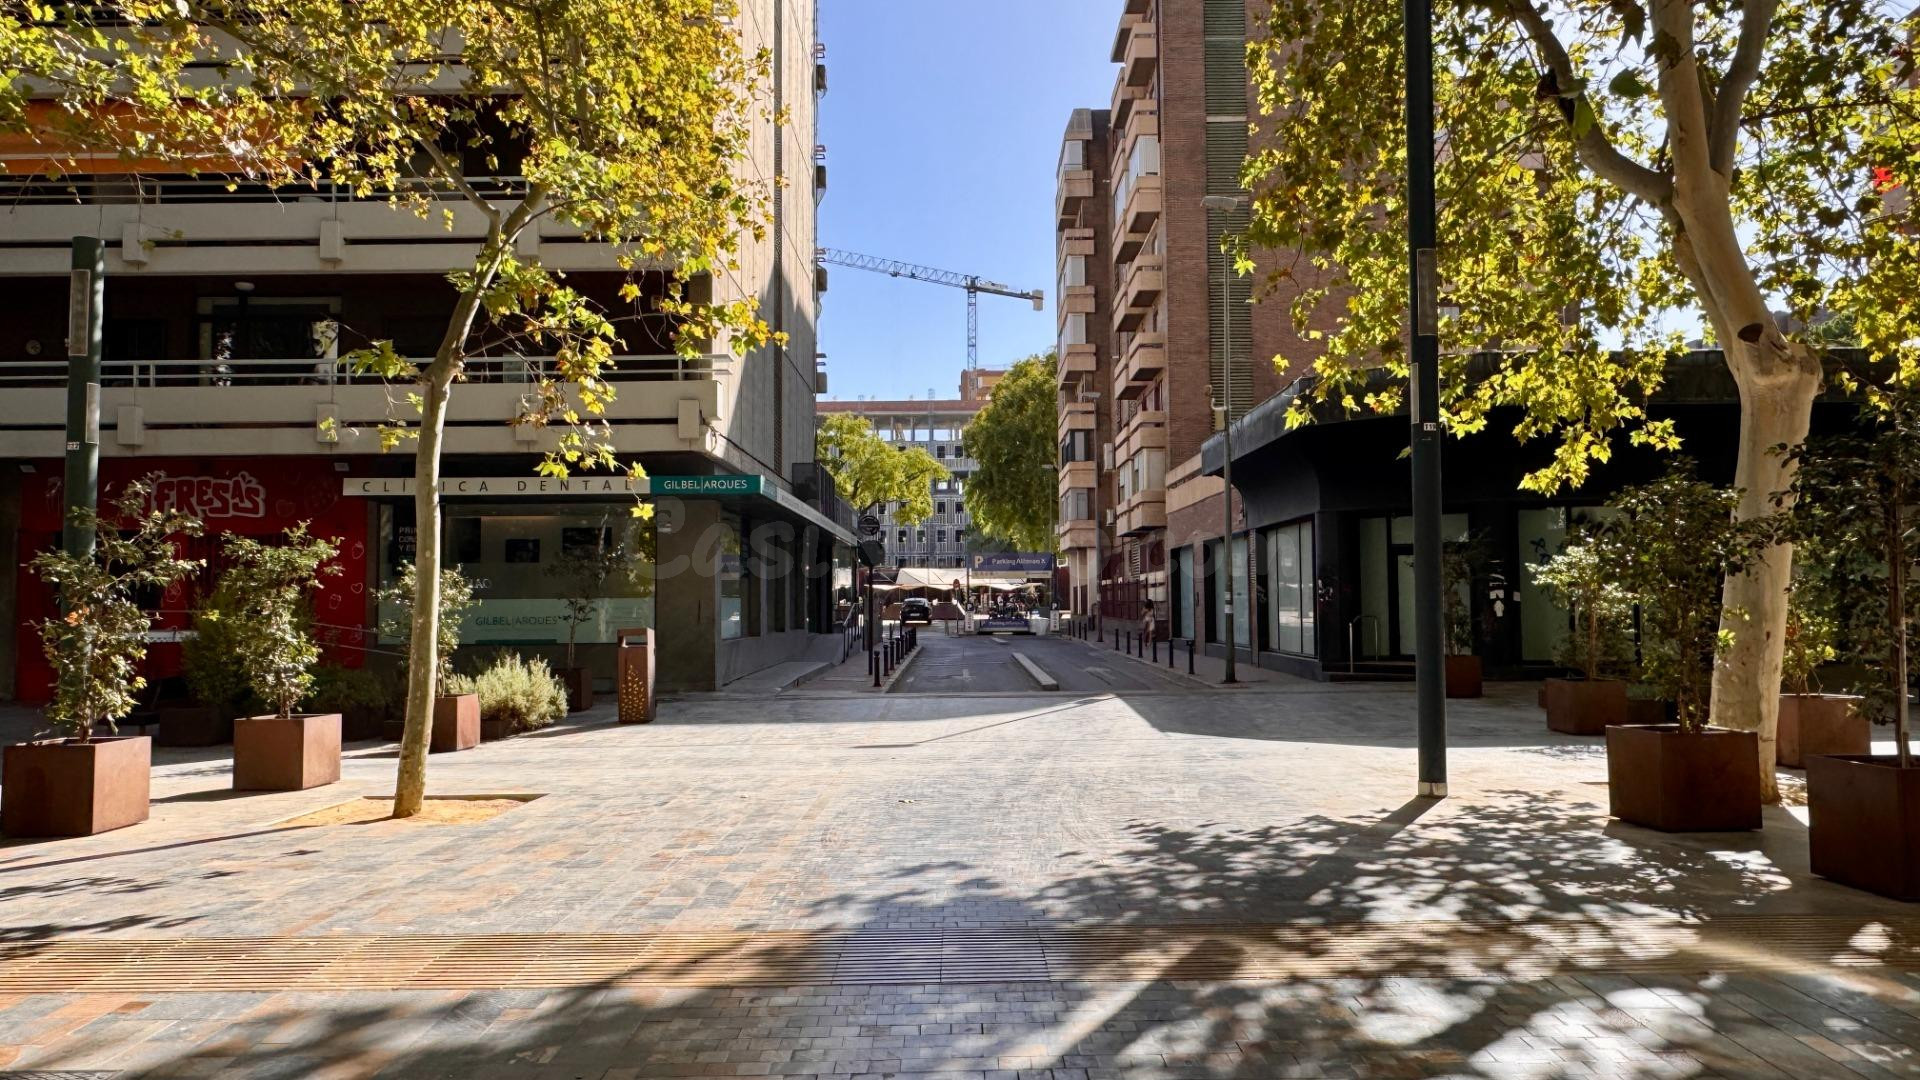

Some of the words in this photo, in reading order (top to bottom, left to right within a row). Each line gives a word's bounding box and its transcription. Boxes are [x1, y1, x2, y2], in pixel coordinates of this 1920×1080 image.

[362, 479, 488, 493] CLÍICA
[517, 480, 632, 492] DENTAL
[663, 480, 700, 490] GILBEL
[703, 479, 748, 489] ARQUES
[991, 558, 1016, 566] Parking
